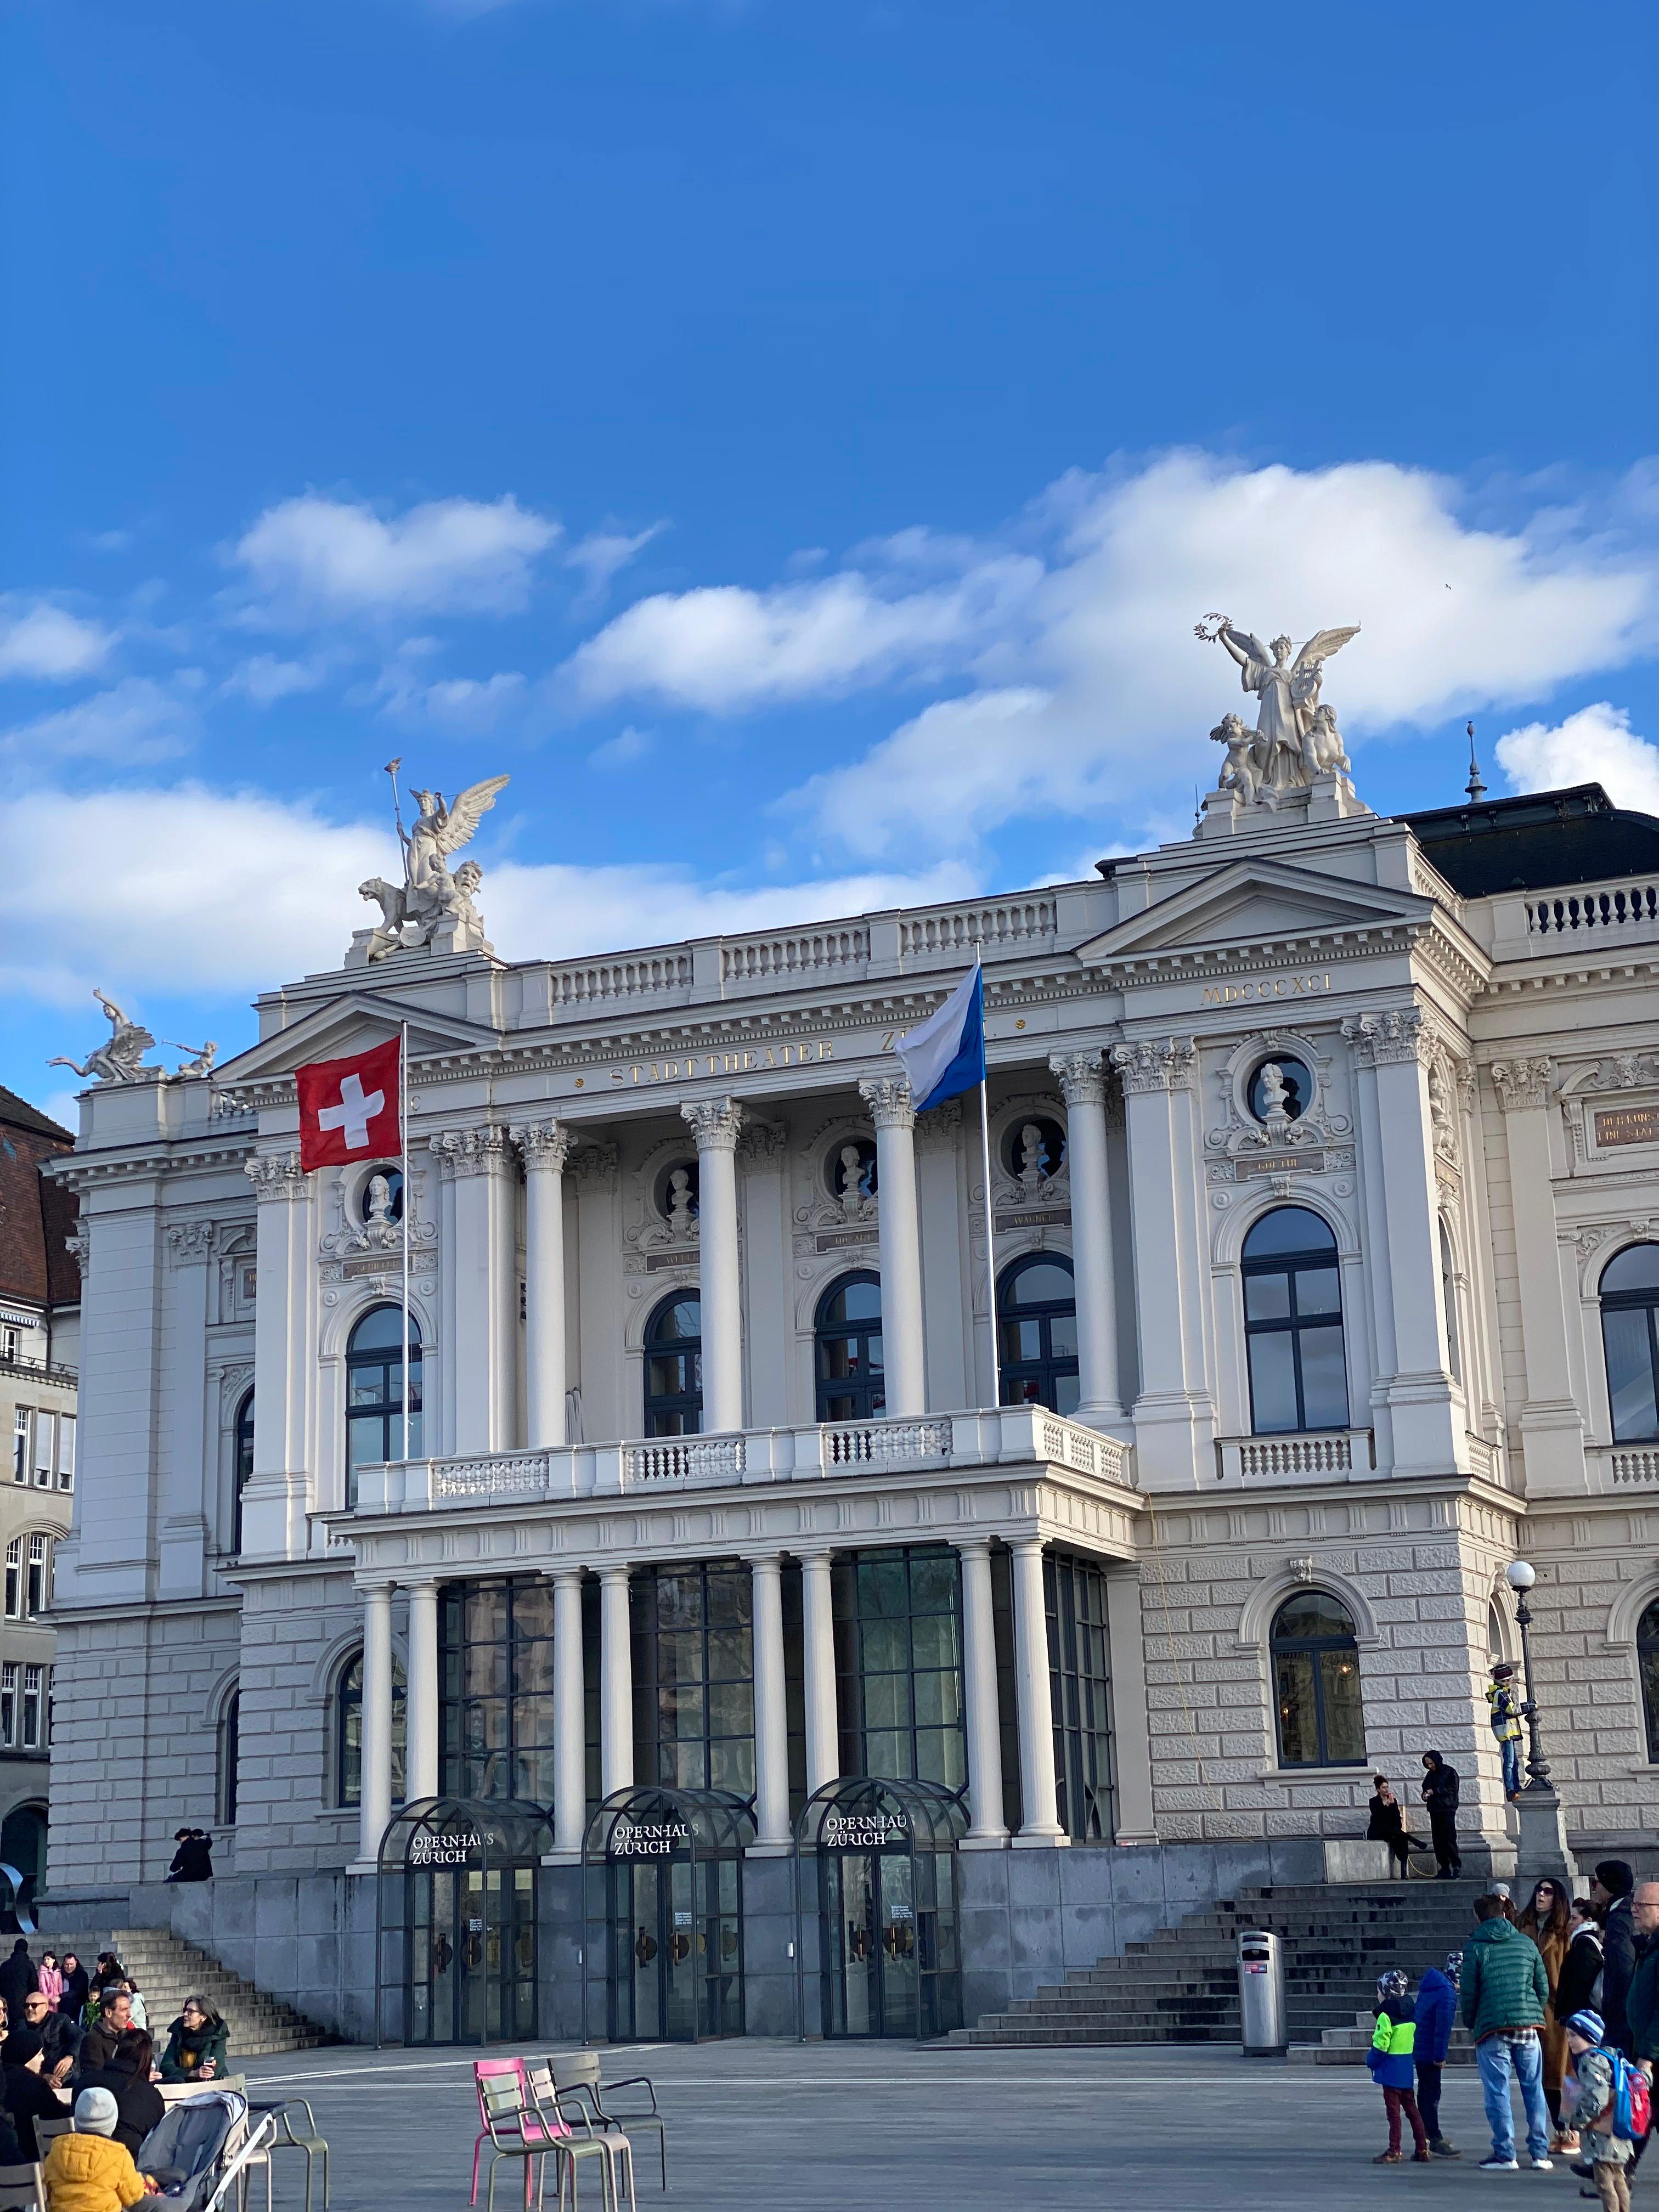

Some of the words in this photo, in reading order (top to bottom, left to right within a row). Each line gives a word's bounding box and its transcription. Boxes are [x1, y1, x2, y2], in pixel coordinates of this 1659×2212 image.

[1200, 973, 1331, 1006] MDCCCXCI
[610, 1040, 836, 1086] STADTTHEATER
[835, 1233, 873, 1245] MOART
[614, 1823, 699, 1839] OPERNHAUS
[827, 1831, 887, 1847] ZÜRICH
[614, 1839, 671, 1855] ZÜRICH
[412, 1849, 466, 1865] ZÜRICH
